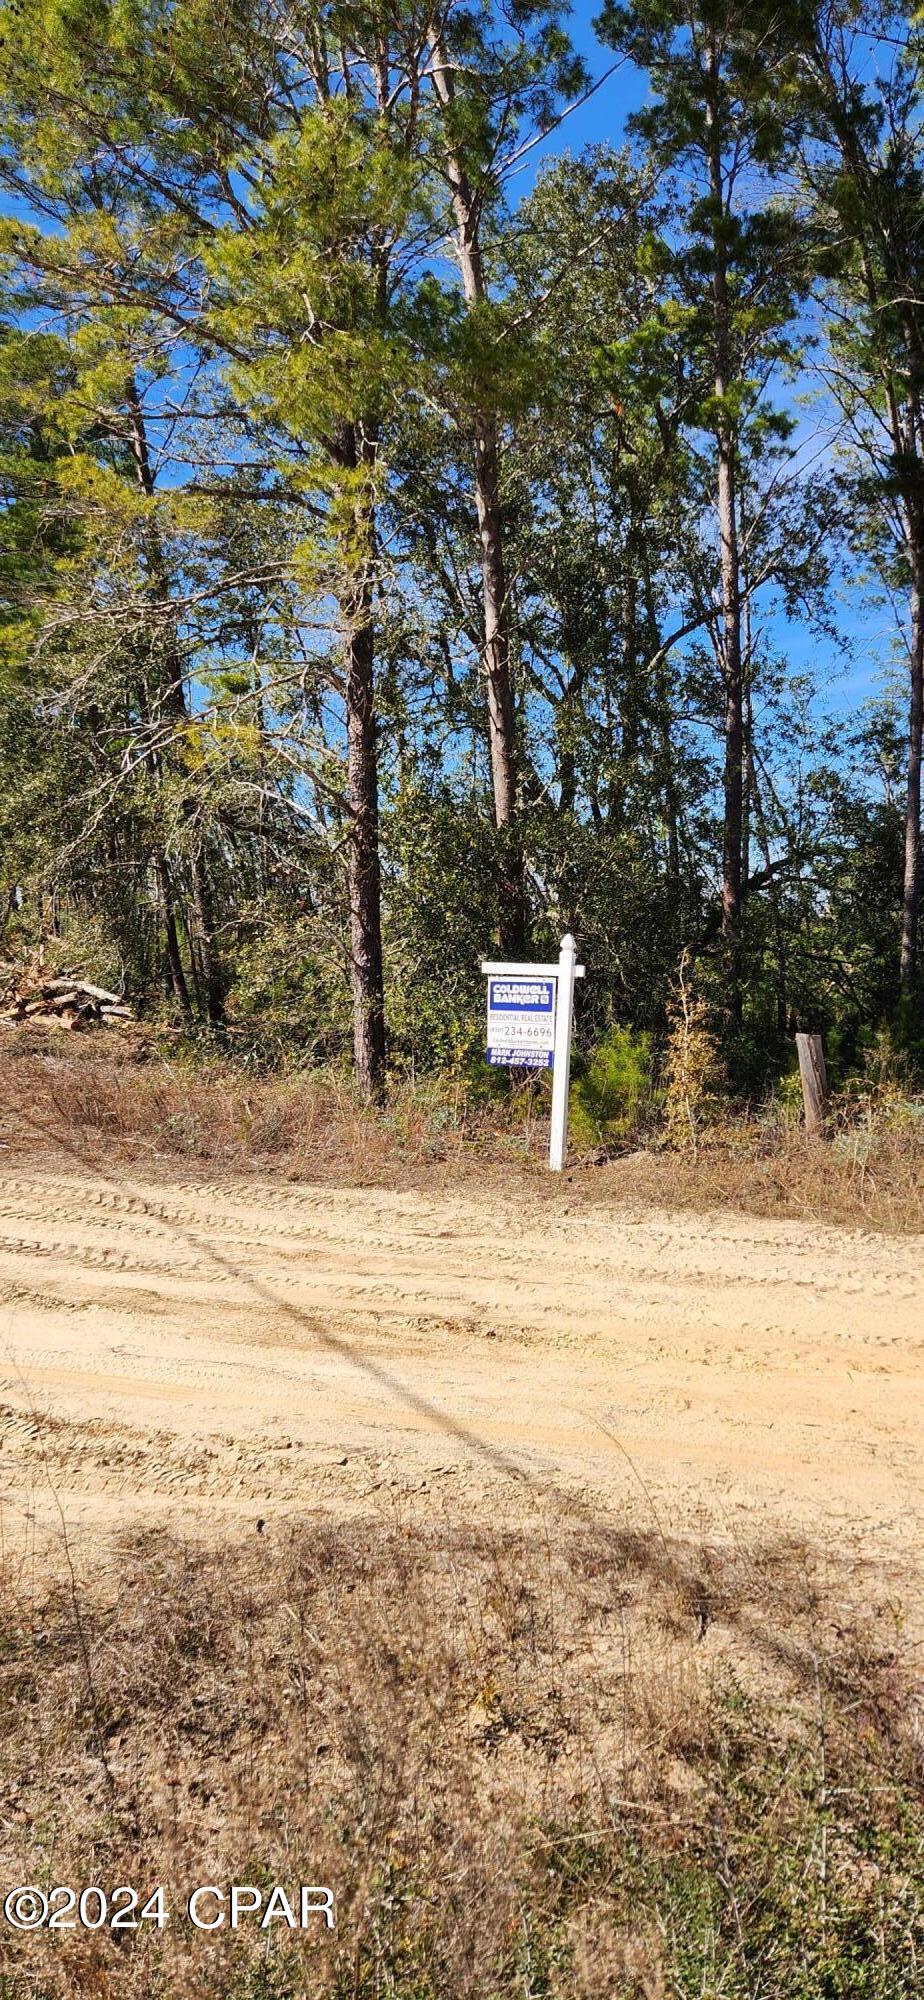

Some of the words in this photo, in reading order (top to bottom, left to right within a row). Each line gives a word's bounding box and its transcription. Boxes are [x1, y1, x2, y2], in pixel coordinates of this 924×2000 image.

[504, 1026, 552, 1037] 234-6696
[490, 1049, 511, 1057] MARK
[511, 1050, 550, 1058] JOHNSTON
